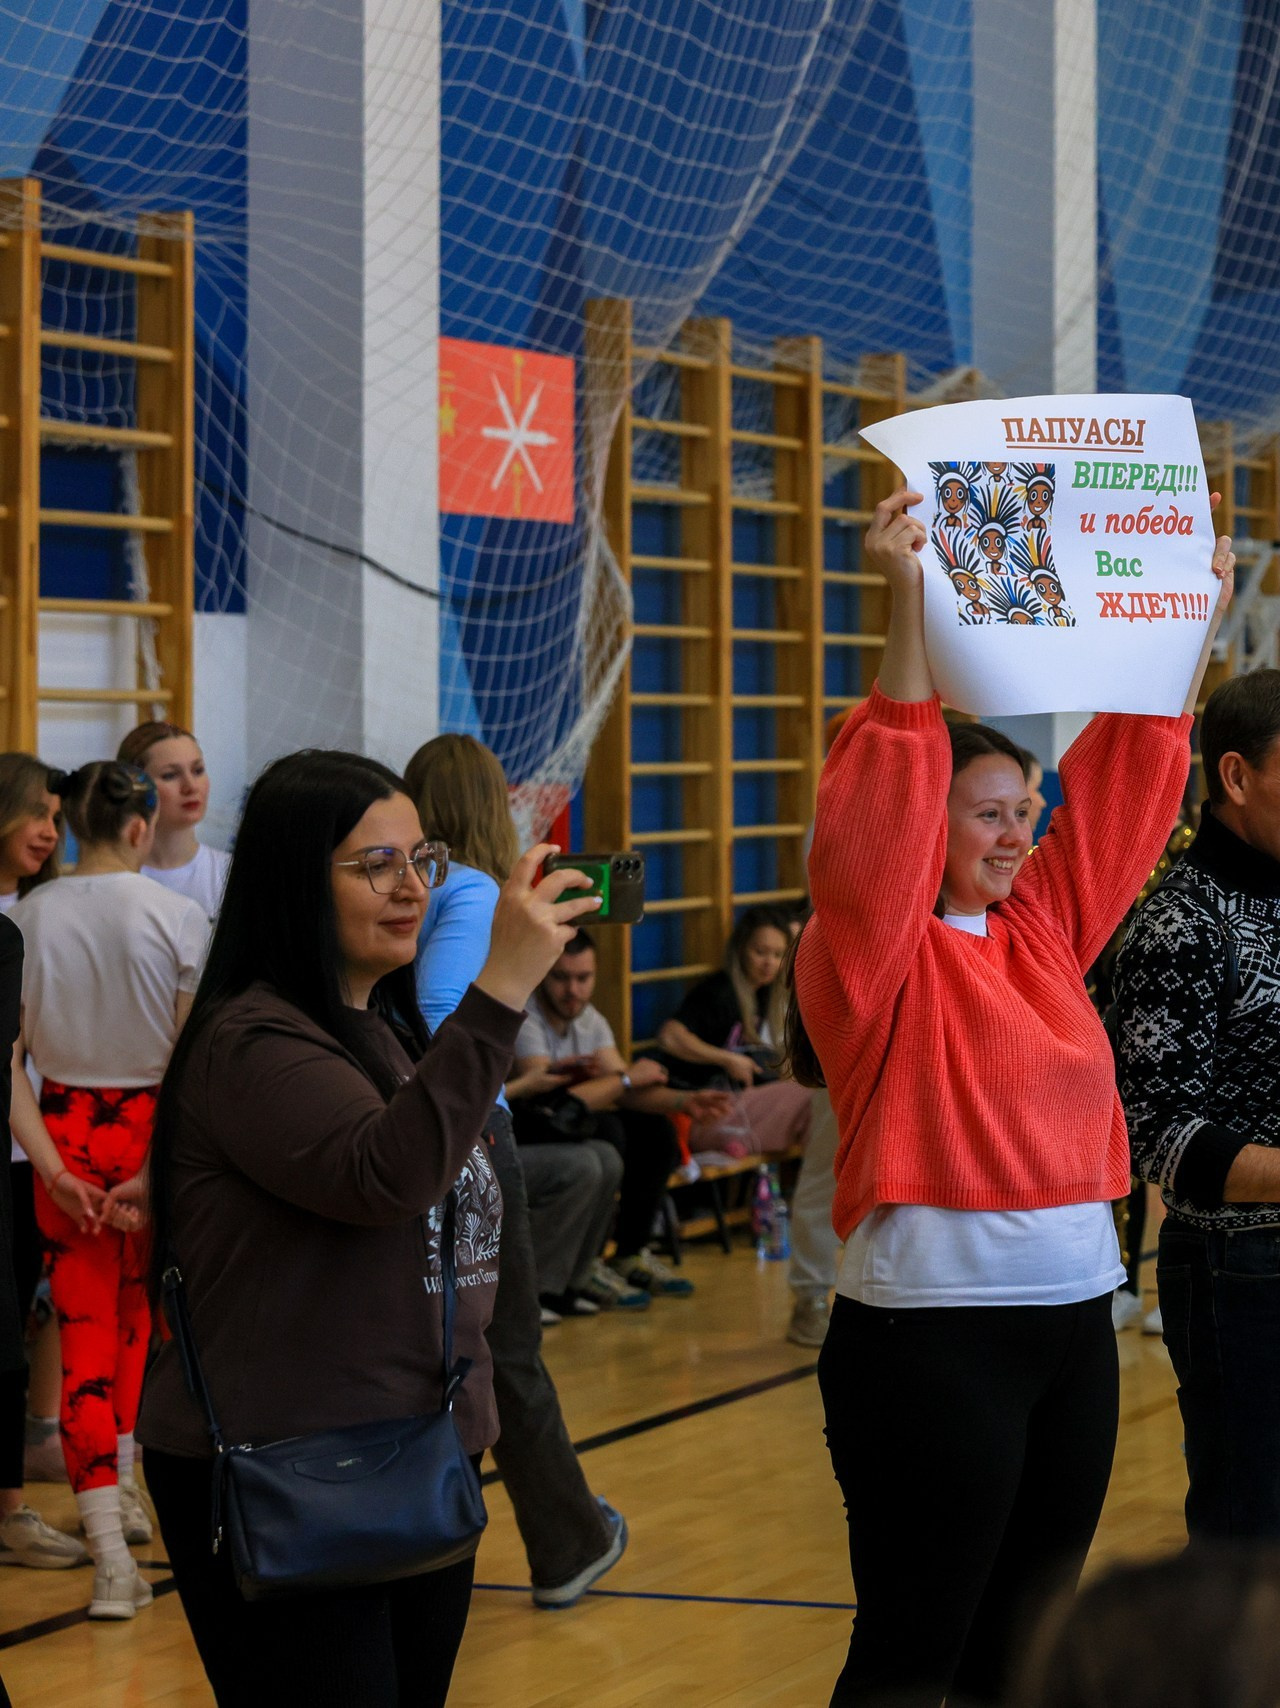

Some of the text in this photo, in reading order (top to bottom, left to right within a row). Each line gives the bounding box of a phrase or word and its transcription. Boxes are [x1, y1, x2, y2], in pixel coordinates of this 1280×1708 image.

[1001, 417, 1146, 446] ПАПУАСЫ
[1072, 460, 1198, 497] ВПЕРЕД!!!
[1079, 505, 1194, 536] и победа
[1095, 549, 1143, 578] Вас
[1096, 591, 1209, 624] ЖДЕТ!!!!
